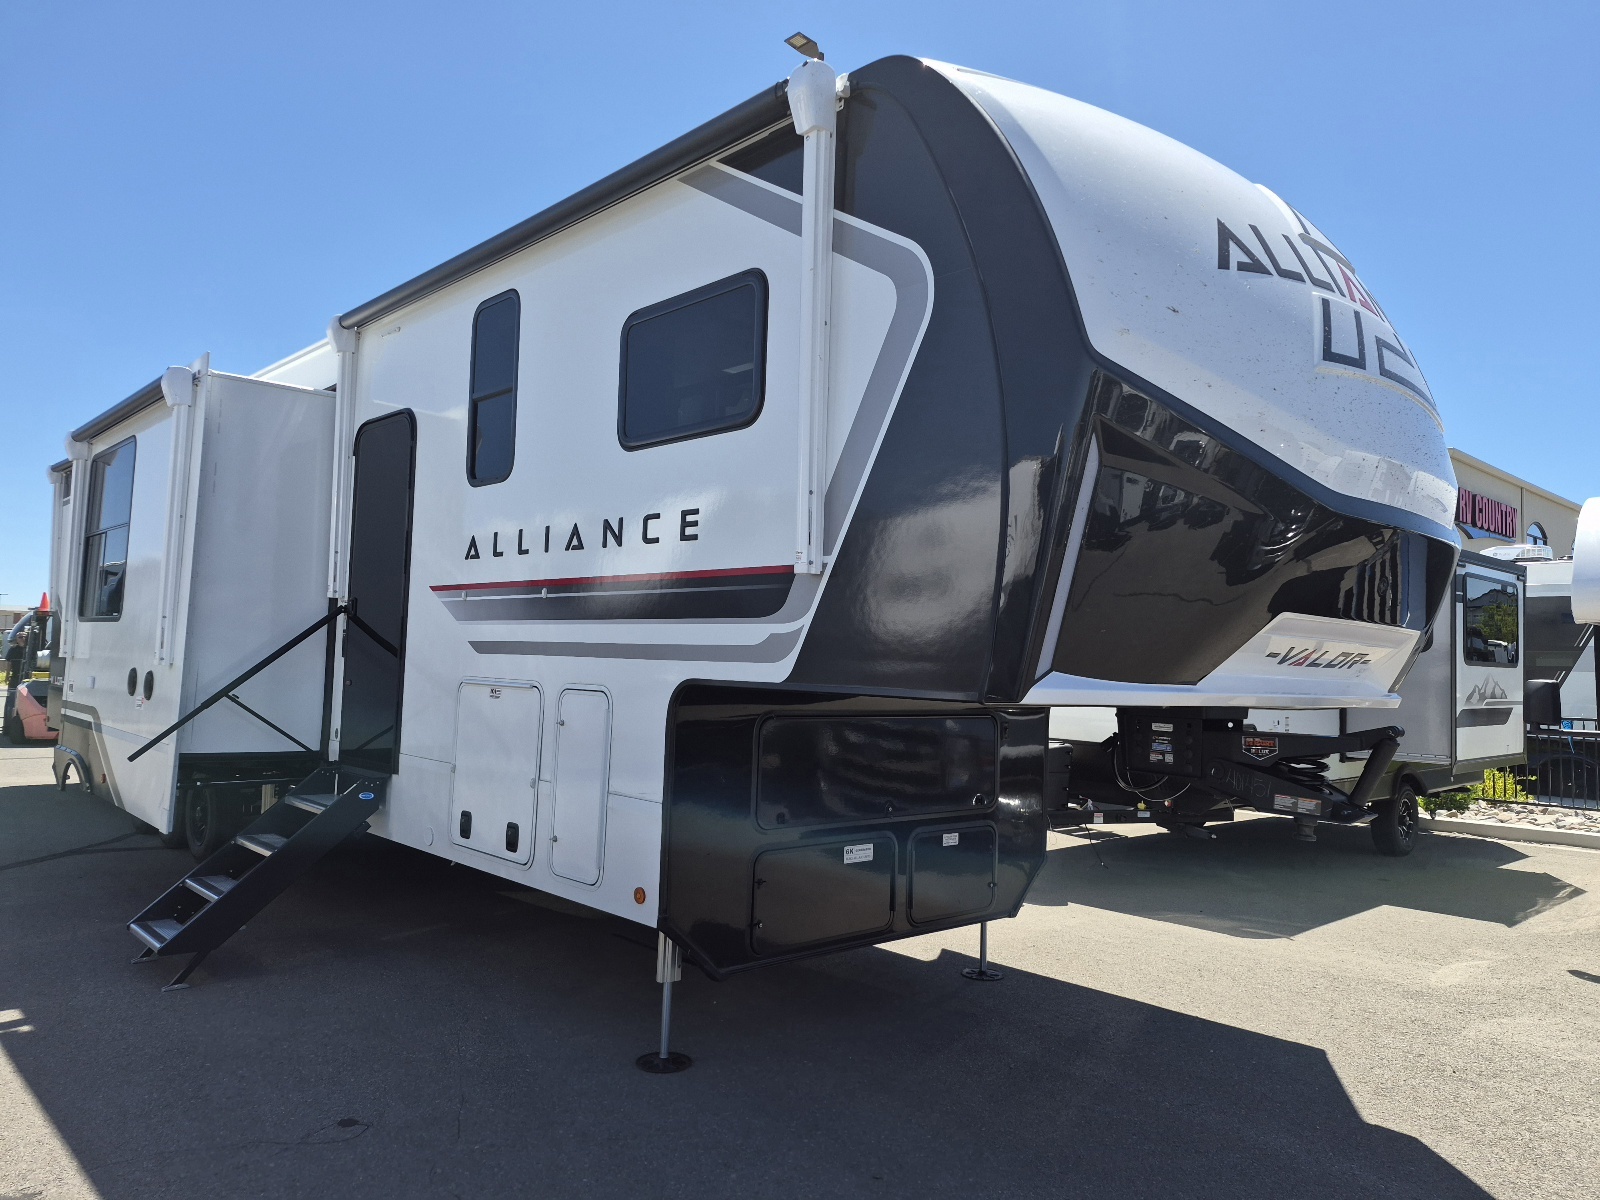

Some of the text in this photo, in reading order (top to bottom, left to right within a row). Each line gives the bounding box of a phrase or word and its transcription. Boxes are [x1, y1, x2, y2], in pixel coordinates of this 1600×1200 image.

[464, 507, 699, 560] ALLIANCE
[1457, 487, 1518, 539] RV COUNTRY
